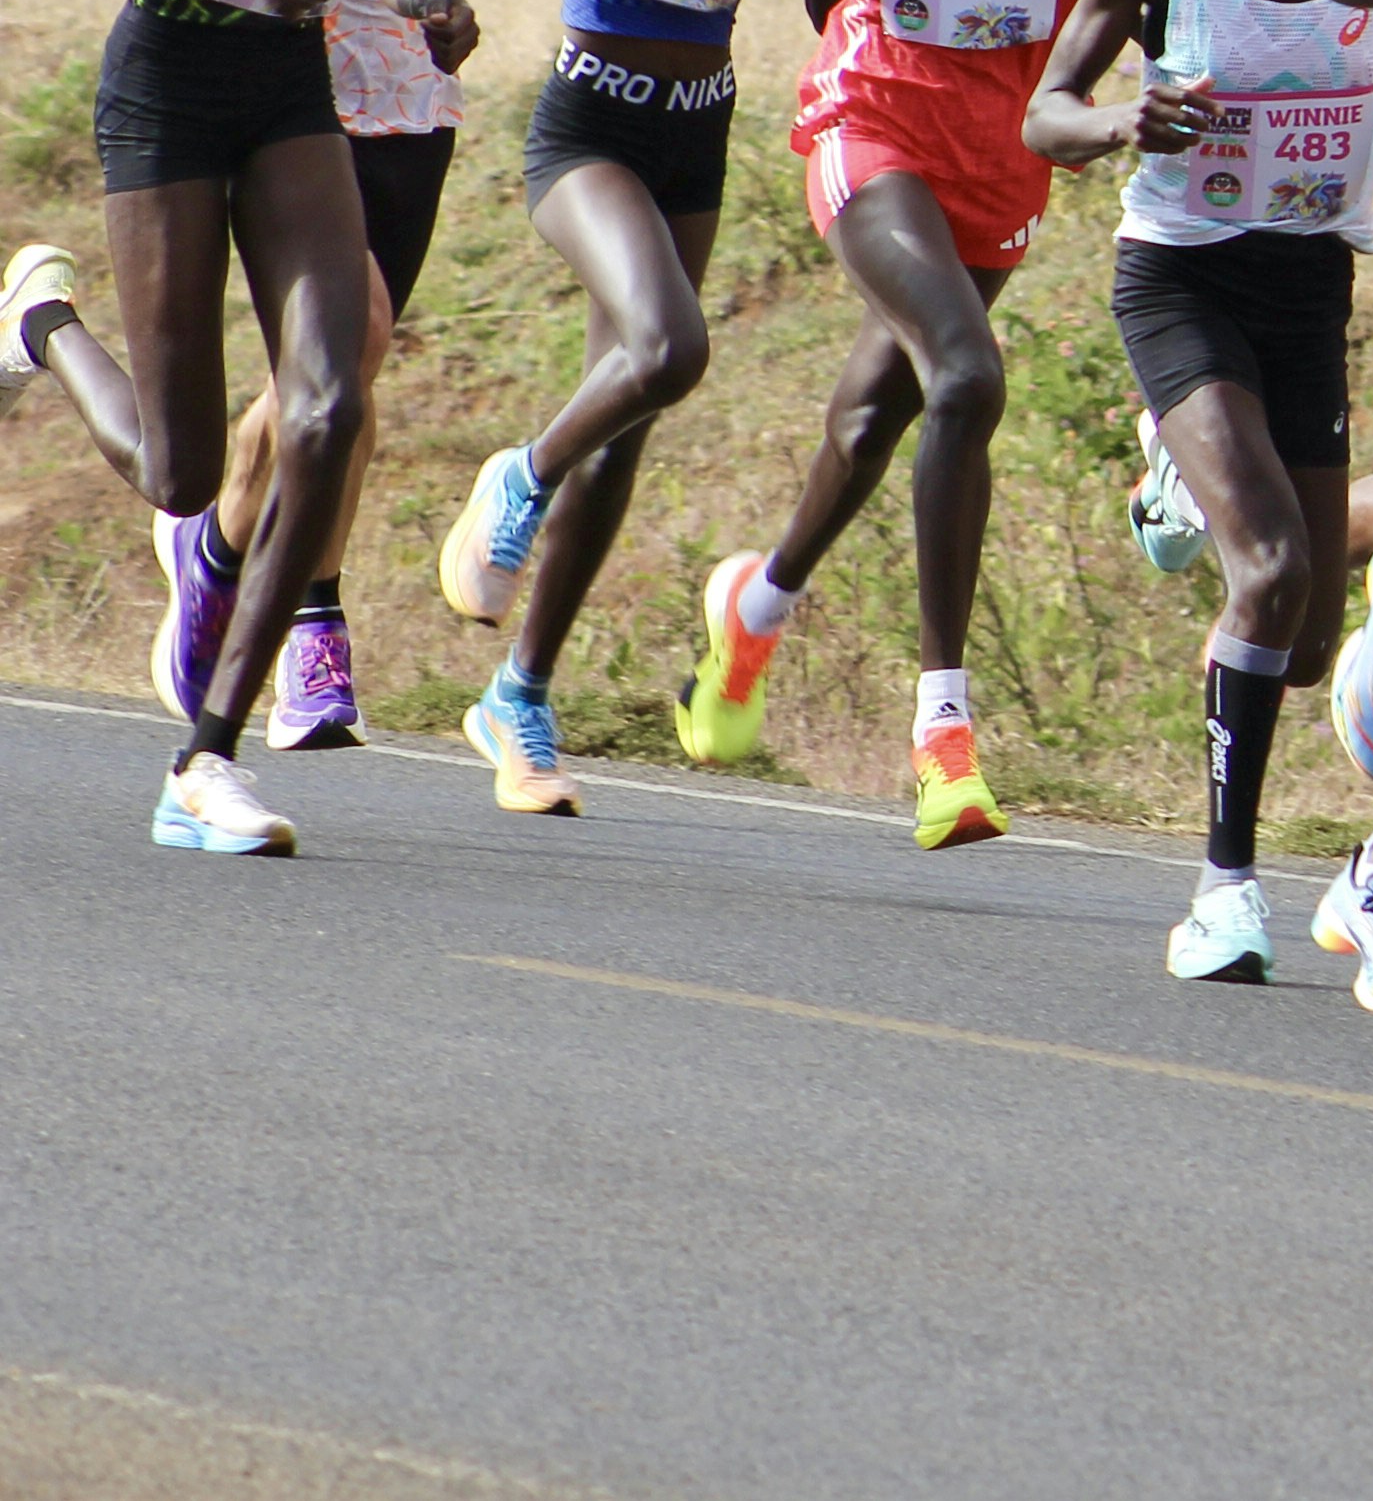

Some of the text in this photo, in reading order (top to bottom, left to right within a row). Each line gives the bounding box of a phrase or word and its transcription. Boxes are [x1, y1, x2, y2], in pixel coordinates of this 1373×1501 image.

[567, 51, 656, 105] PRO
[665, 60, 735, 111] NIKE
[1266, 104, 1363, 129] WINNIE
[1274, 130, 1351, 163] 483
